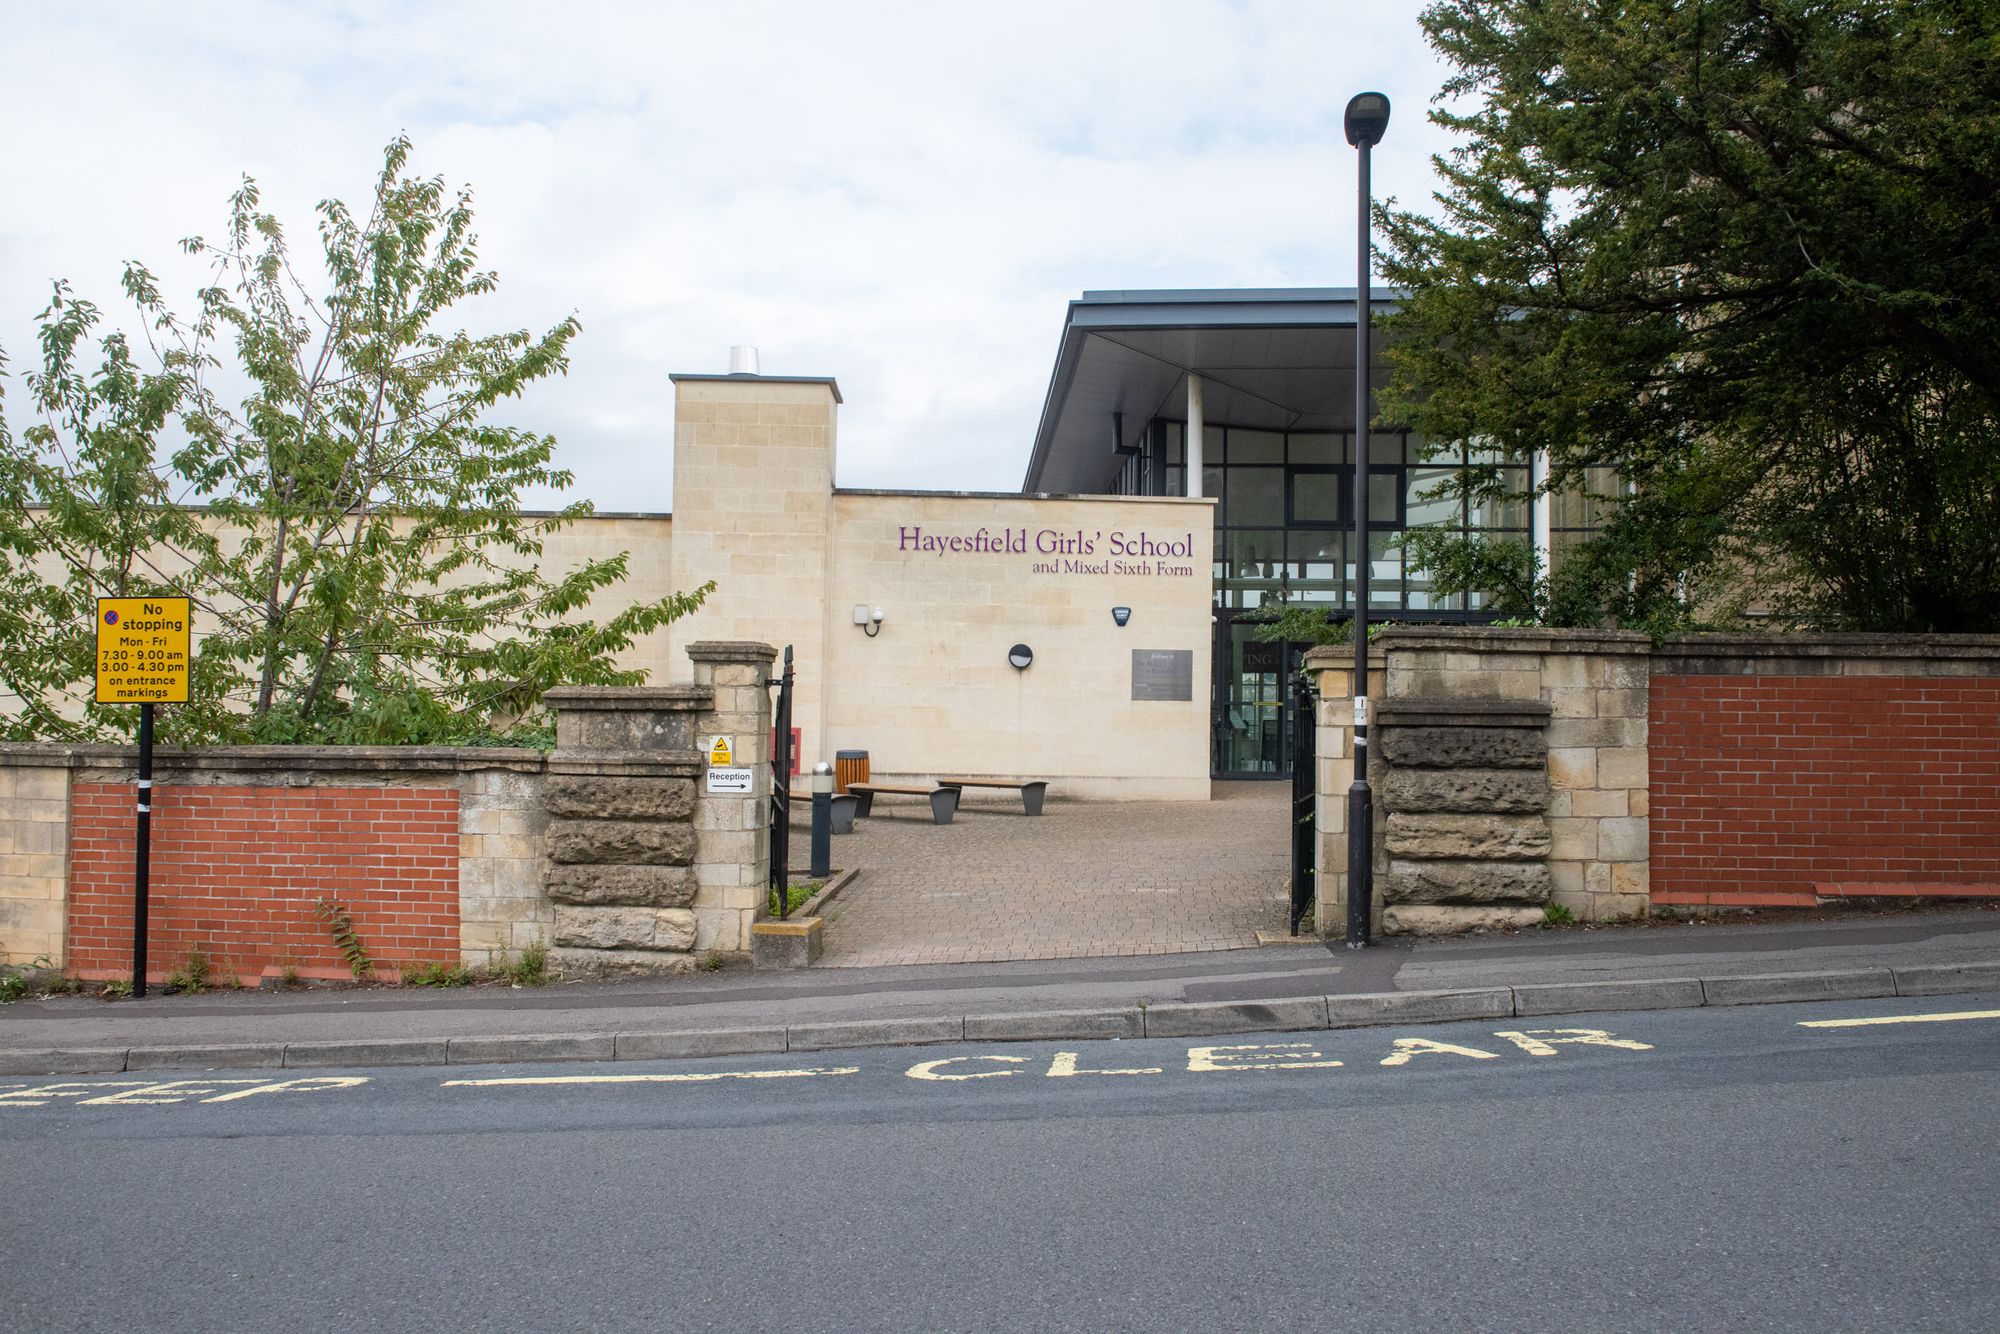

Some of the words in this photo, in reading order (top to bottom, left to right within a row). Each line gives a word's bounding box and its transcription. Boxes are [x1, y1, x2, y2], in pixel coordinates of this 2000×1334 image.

[898, 526, 1027, 557] Hayesfield
[1110, 531, 1194, 558] School
[1032, 559, 1059, 574] and
[1064, 559, 1109, 576] Mixed
[1113, 560, 1151, 576] Sixth
[1156, 561, 1194, 577] Form
[143, 603, 163, 615] No
[122, 619, 183, 632] stopping
[119, 637, 144, 646] Mon
[152, 637, 167, 646] Fri
[102, 651, 128, 660] 7.30
[137, 651, 164, 660] 9.00
[166, 652, 183, 660] am
[101, 662, 129, 672] 3.00
[137, 662, 165, 672] 4.30
[167, 664, 184, 673] pm
[109, 677, 123, 685] on
[126, 676, 176, 685] entrance
[116, 688, 168, 698] markings
[709, 772, 750, 781] Reception
[903, 1028, 1656, 1082] CLEAR
